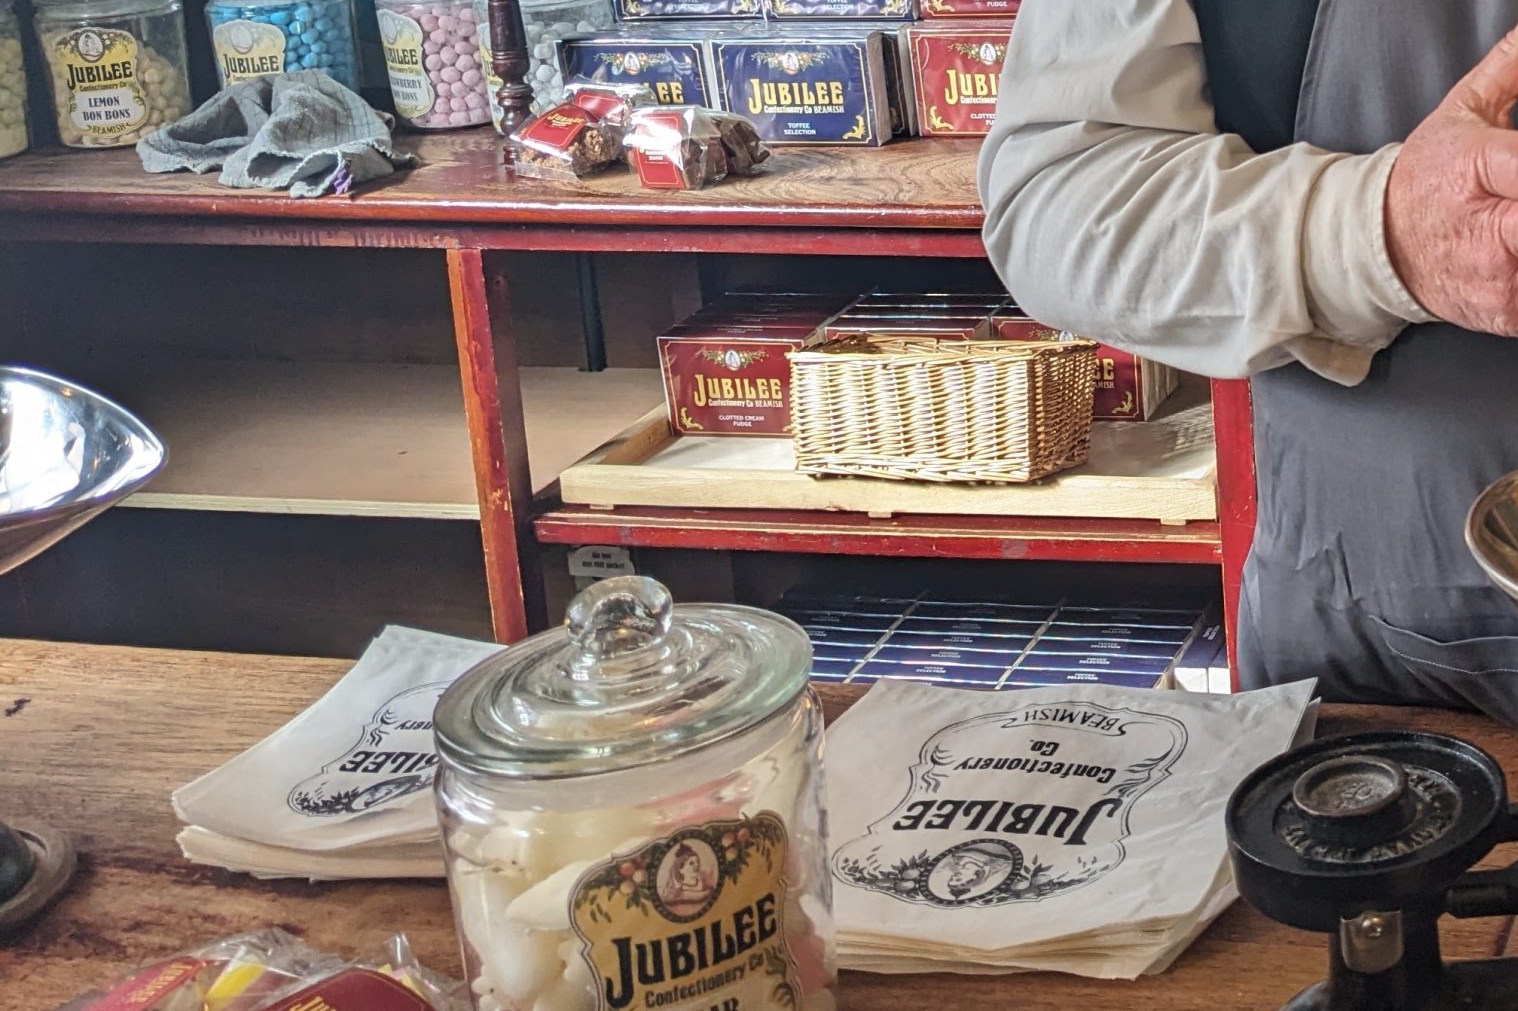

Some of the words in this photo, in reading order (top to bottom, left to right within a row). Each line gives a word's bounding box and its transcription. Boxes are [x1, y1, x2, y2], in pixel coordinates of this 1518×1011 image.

[67, 61, 133, 90] JUBILEE
[223, 53, 279, 76] JUBILEE
[88, 95, 120, 107] LEMON
[749, 79, 844, 114] JUBILEE
[944, 69, 1000, 105] JUBI
[83, 111, 103, 122] BON
[104, 108, 131, 120] BONS
[813, 105, 845, 114] BEAMISH
[694, 374, 783, 407] JUBILEE
[755, 400, 784, 408] BEAMISH
[1024, 709, 1121, 733] BEAMISH
[1029, 739, 1059, 754] Co.
[953, 756, 1117, 784] Confectionery
[893, 797, 1123, 845] JUBILEE
[604, 893, 777, 1009] JUBILEE
[645, 964, 745, 1008] Confectionery
